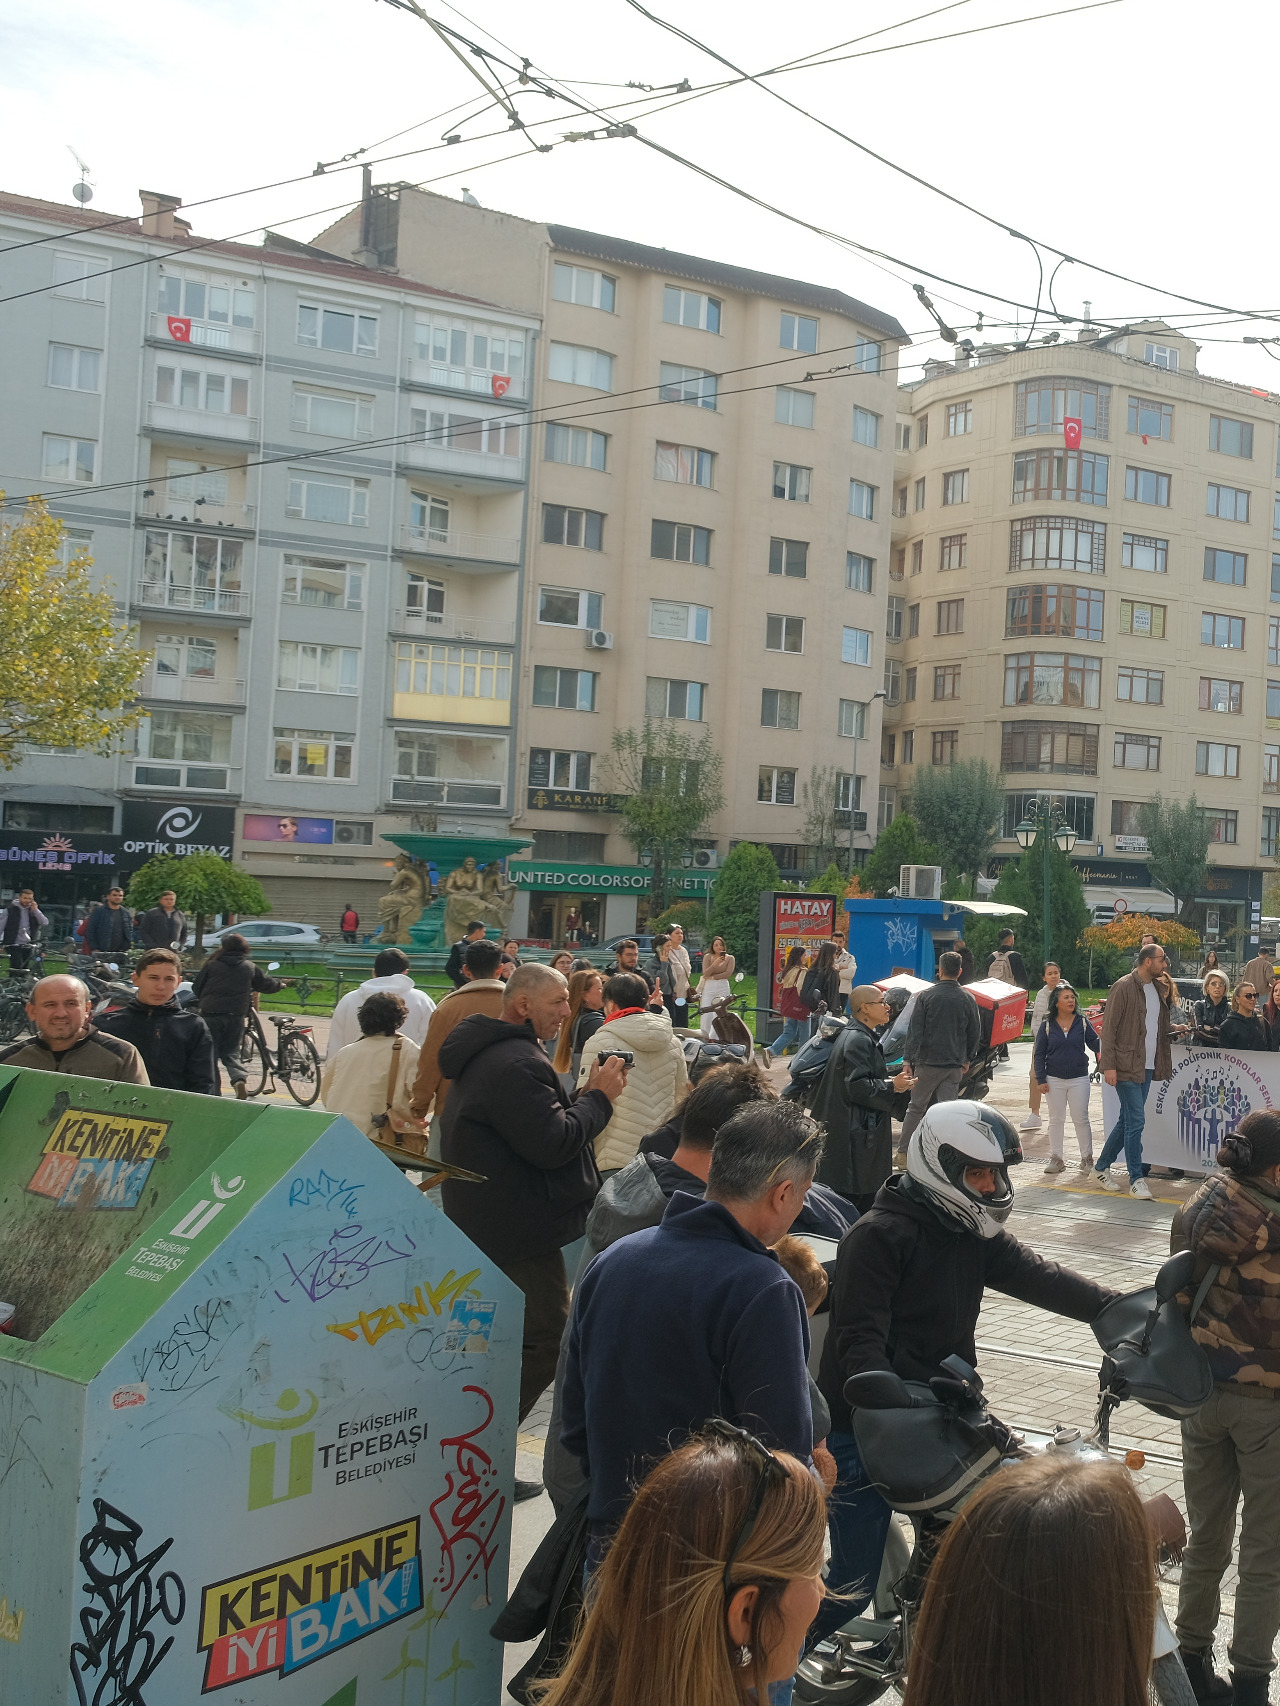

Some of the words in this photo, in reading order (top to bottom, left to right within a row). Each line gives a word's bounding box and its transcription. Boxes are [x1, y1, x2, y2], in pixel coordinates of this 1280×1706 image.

[554, 793, 609, 806] KARANF
[64, 850, 116, 865] OPTİK
[124, 839, 169, 854] OPTİK
[175, 843, 231, 858] BEYAZ
[508, 870, 564, 886] UNITED
[781, 900, 832, 916] HATAY
[1178, 1050, 1222, 1070] POLİFONİK
[1224, 1053, 1262, 1085] KOROLAR
[1201, 1159, 1219, 1169] 202
[151, 1238, 191, 1255] ESKİŞEHİR
[132, 1247, 185, 1272] TEPEBAŞI
[125, 1265, 166, 1282] BELEDİYESİ
[338, 1406, 418, 1439] ESKİŞEHİR
[318, 1423, 429, 1469] TEPEBAŞI
[335, 1449, 417, 1486] BELEDİYESİ
[218, 1530, 408, 1637] KENTİNE
[226, 1625, 278, 1676] İYİ
[290, 1562, 414, 1663] BAK!
